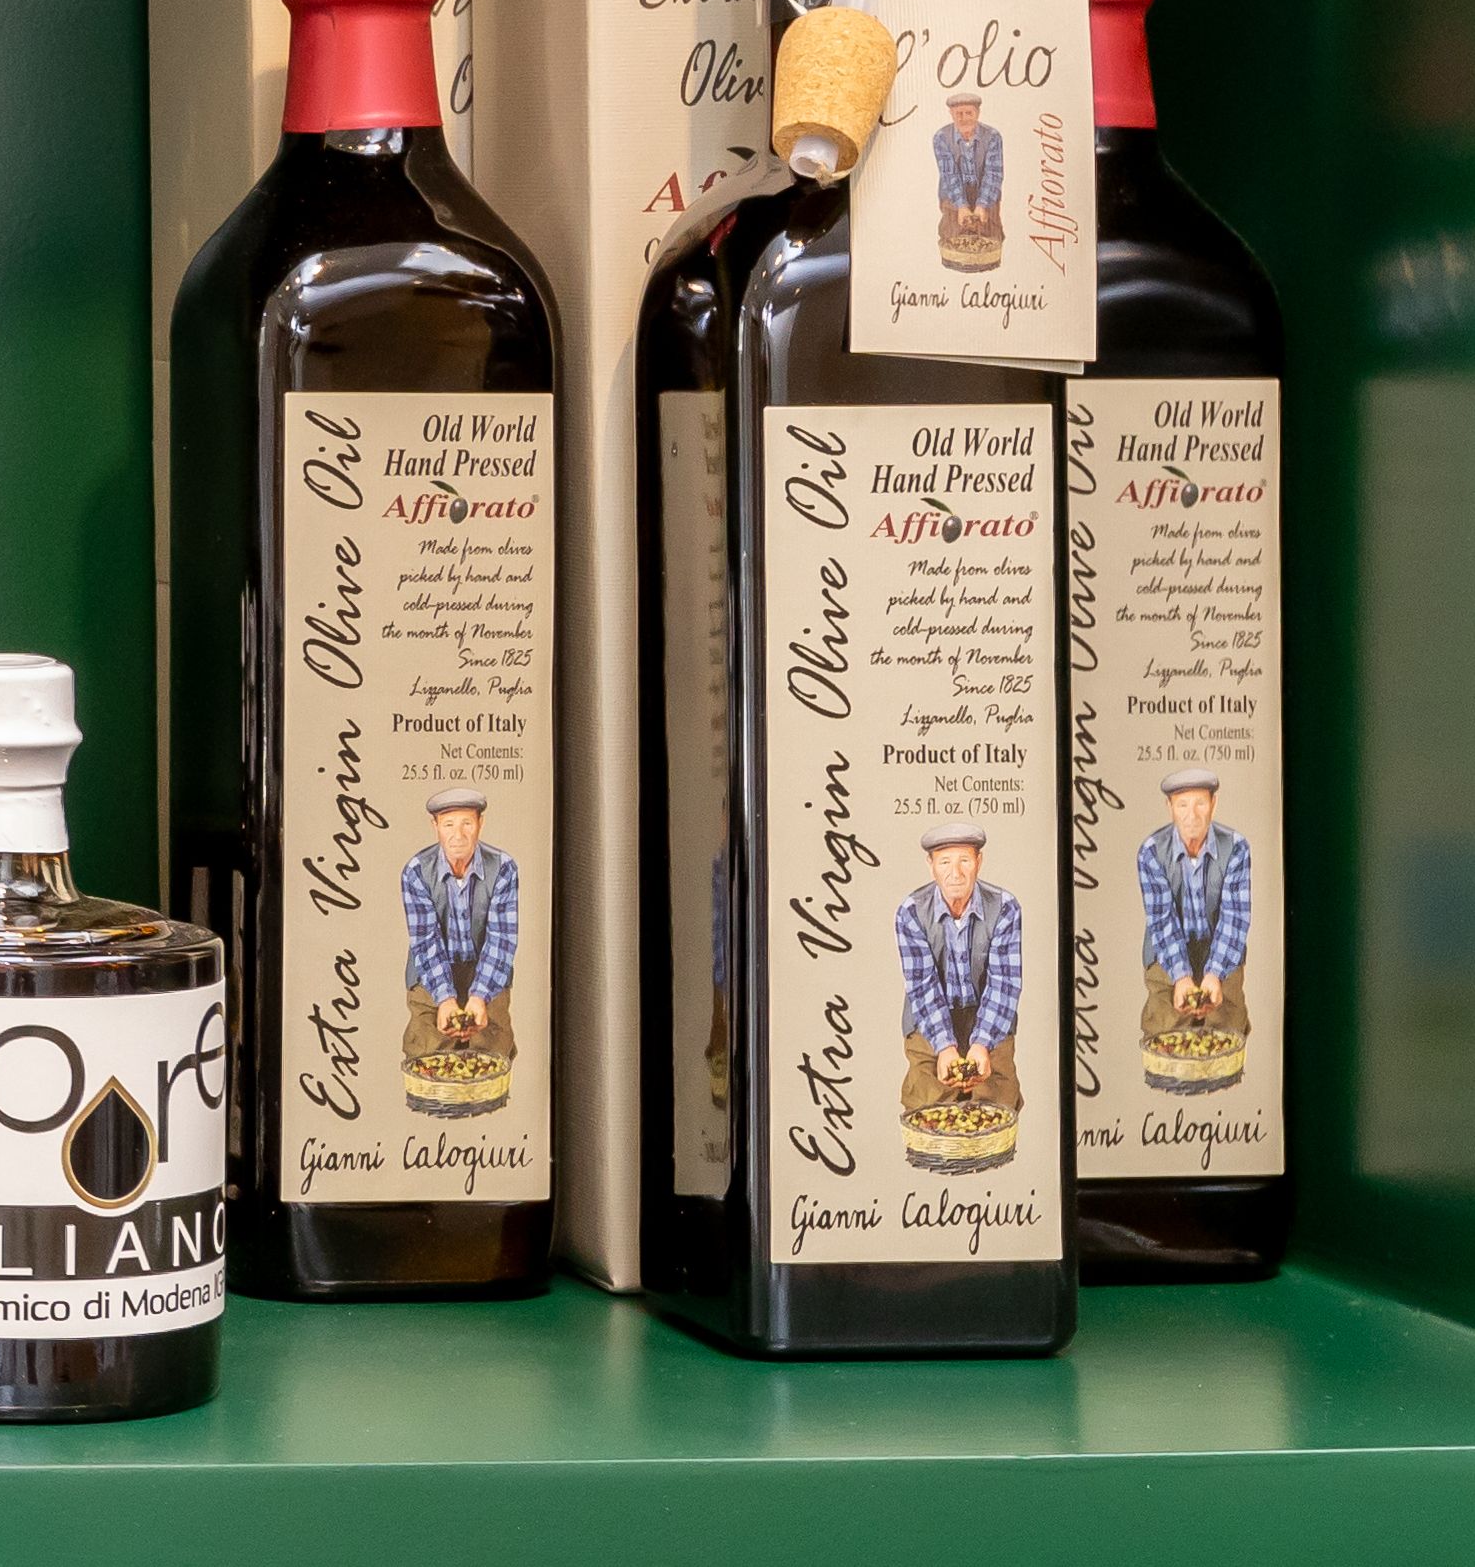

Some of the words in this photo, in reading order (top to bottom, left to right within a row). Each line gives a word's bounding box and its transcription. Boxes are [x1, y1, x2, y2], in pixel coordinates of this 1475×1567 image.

[890, 281, 948, 322] Gianni
[423, 414, 462, 442] Old
[471, 414, 536, 443] World
[912, 427, 954, 457] Old
[963, 427, 1034, 456] World
[303, 410, 363, 510] Oil
[384, 449, 444, 477] Hand
[454, 450, 536, 478] Pressed
[871, 464, 936, 494] Hand
[944, 464, 1035, 493] Pressed
[419, 540, 458, 555] Made
[462, 538, 493, 564] from
[497, 539, 533, 555] olives
[398, 569, 442, 590] picked
[447, 569, 463, 589] by
[465, 568, 501, 584] hand
[506, 568, 533, 584] and
[303, 536, 363, 689] Olive
[458, 649, 497, 668] Since
[501, 649, 533, 667] 1825
[1127, 695, 1193, 716] Product
[1198, 695, 1215, 715] of
[1219, 695, 1257, 719] Italy
[393, 714, 461, 734] Product
[466, 714, 483, 733] of
[488, 714, 527, 738] Italy
[302, 718, 390, 914] Virgin
[299, 949, 362, 1120] Extra
[300, 1135, 385, 1195] Gianni
[84, 1292, 110, 1320] di
[122, 1281, 210, 1318] Modena
